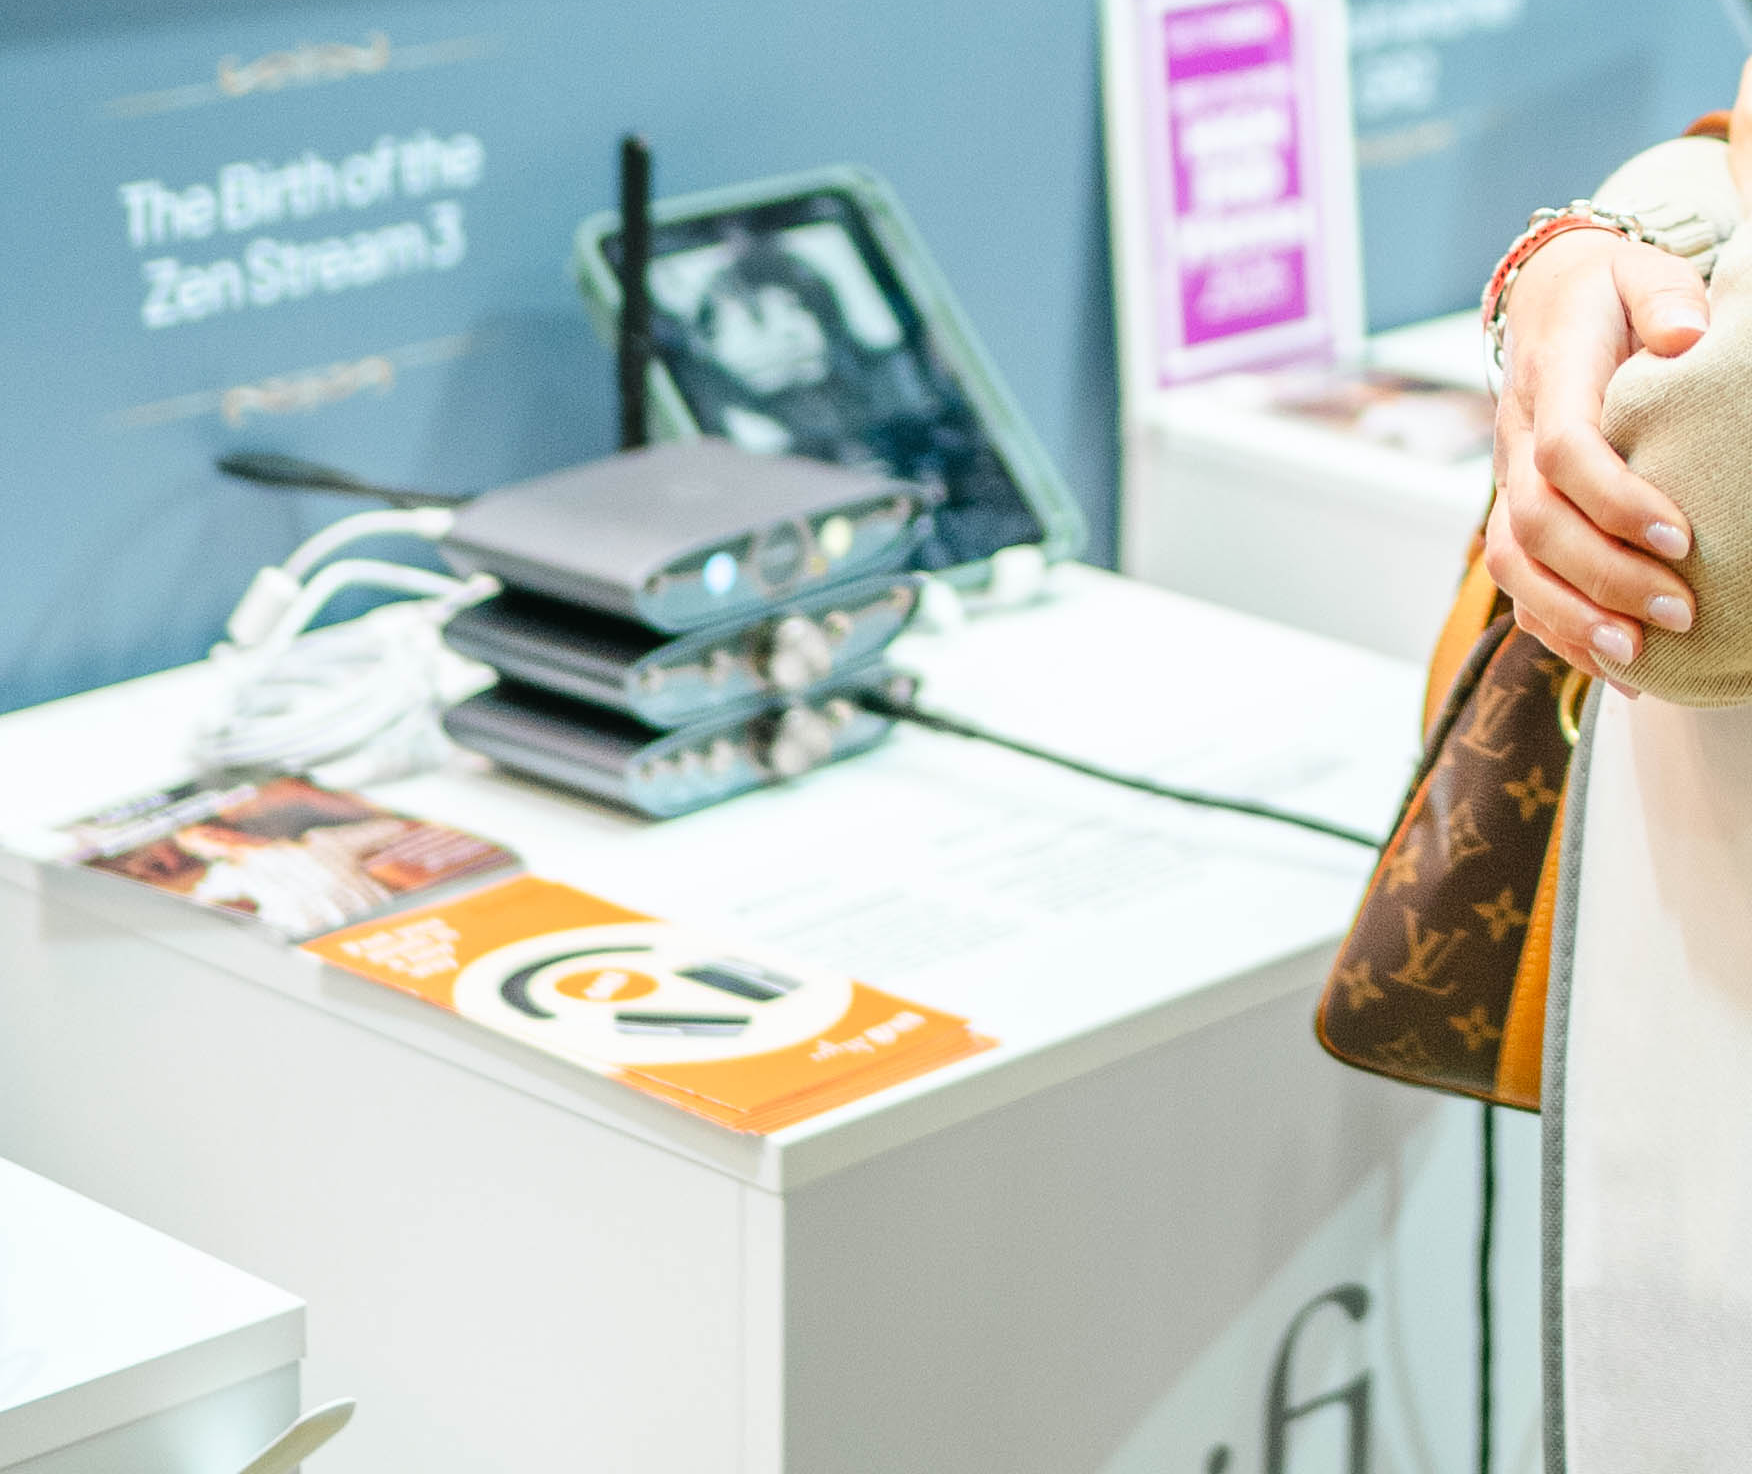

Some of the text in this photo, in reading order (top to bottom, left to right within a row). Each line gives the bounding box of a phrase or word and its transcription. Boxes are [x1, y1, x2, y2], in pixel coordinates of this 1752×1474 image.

[119, 129, 485, 251] The Birth of the
[141, 199, 467, 328] Zen Stream 3
